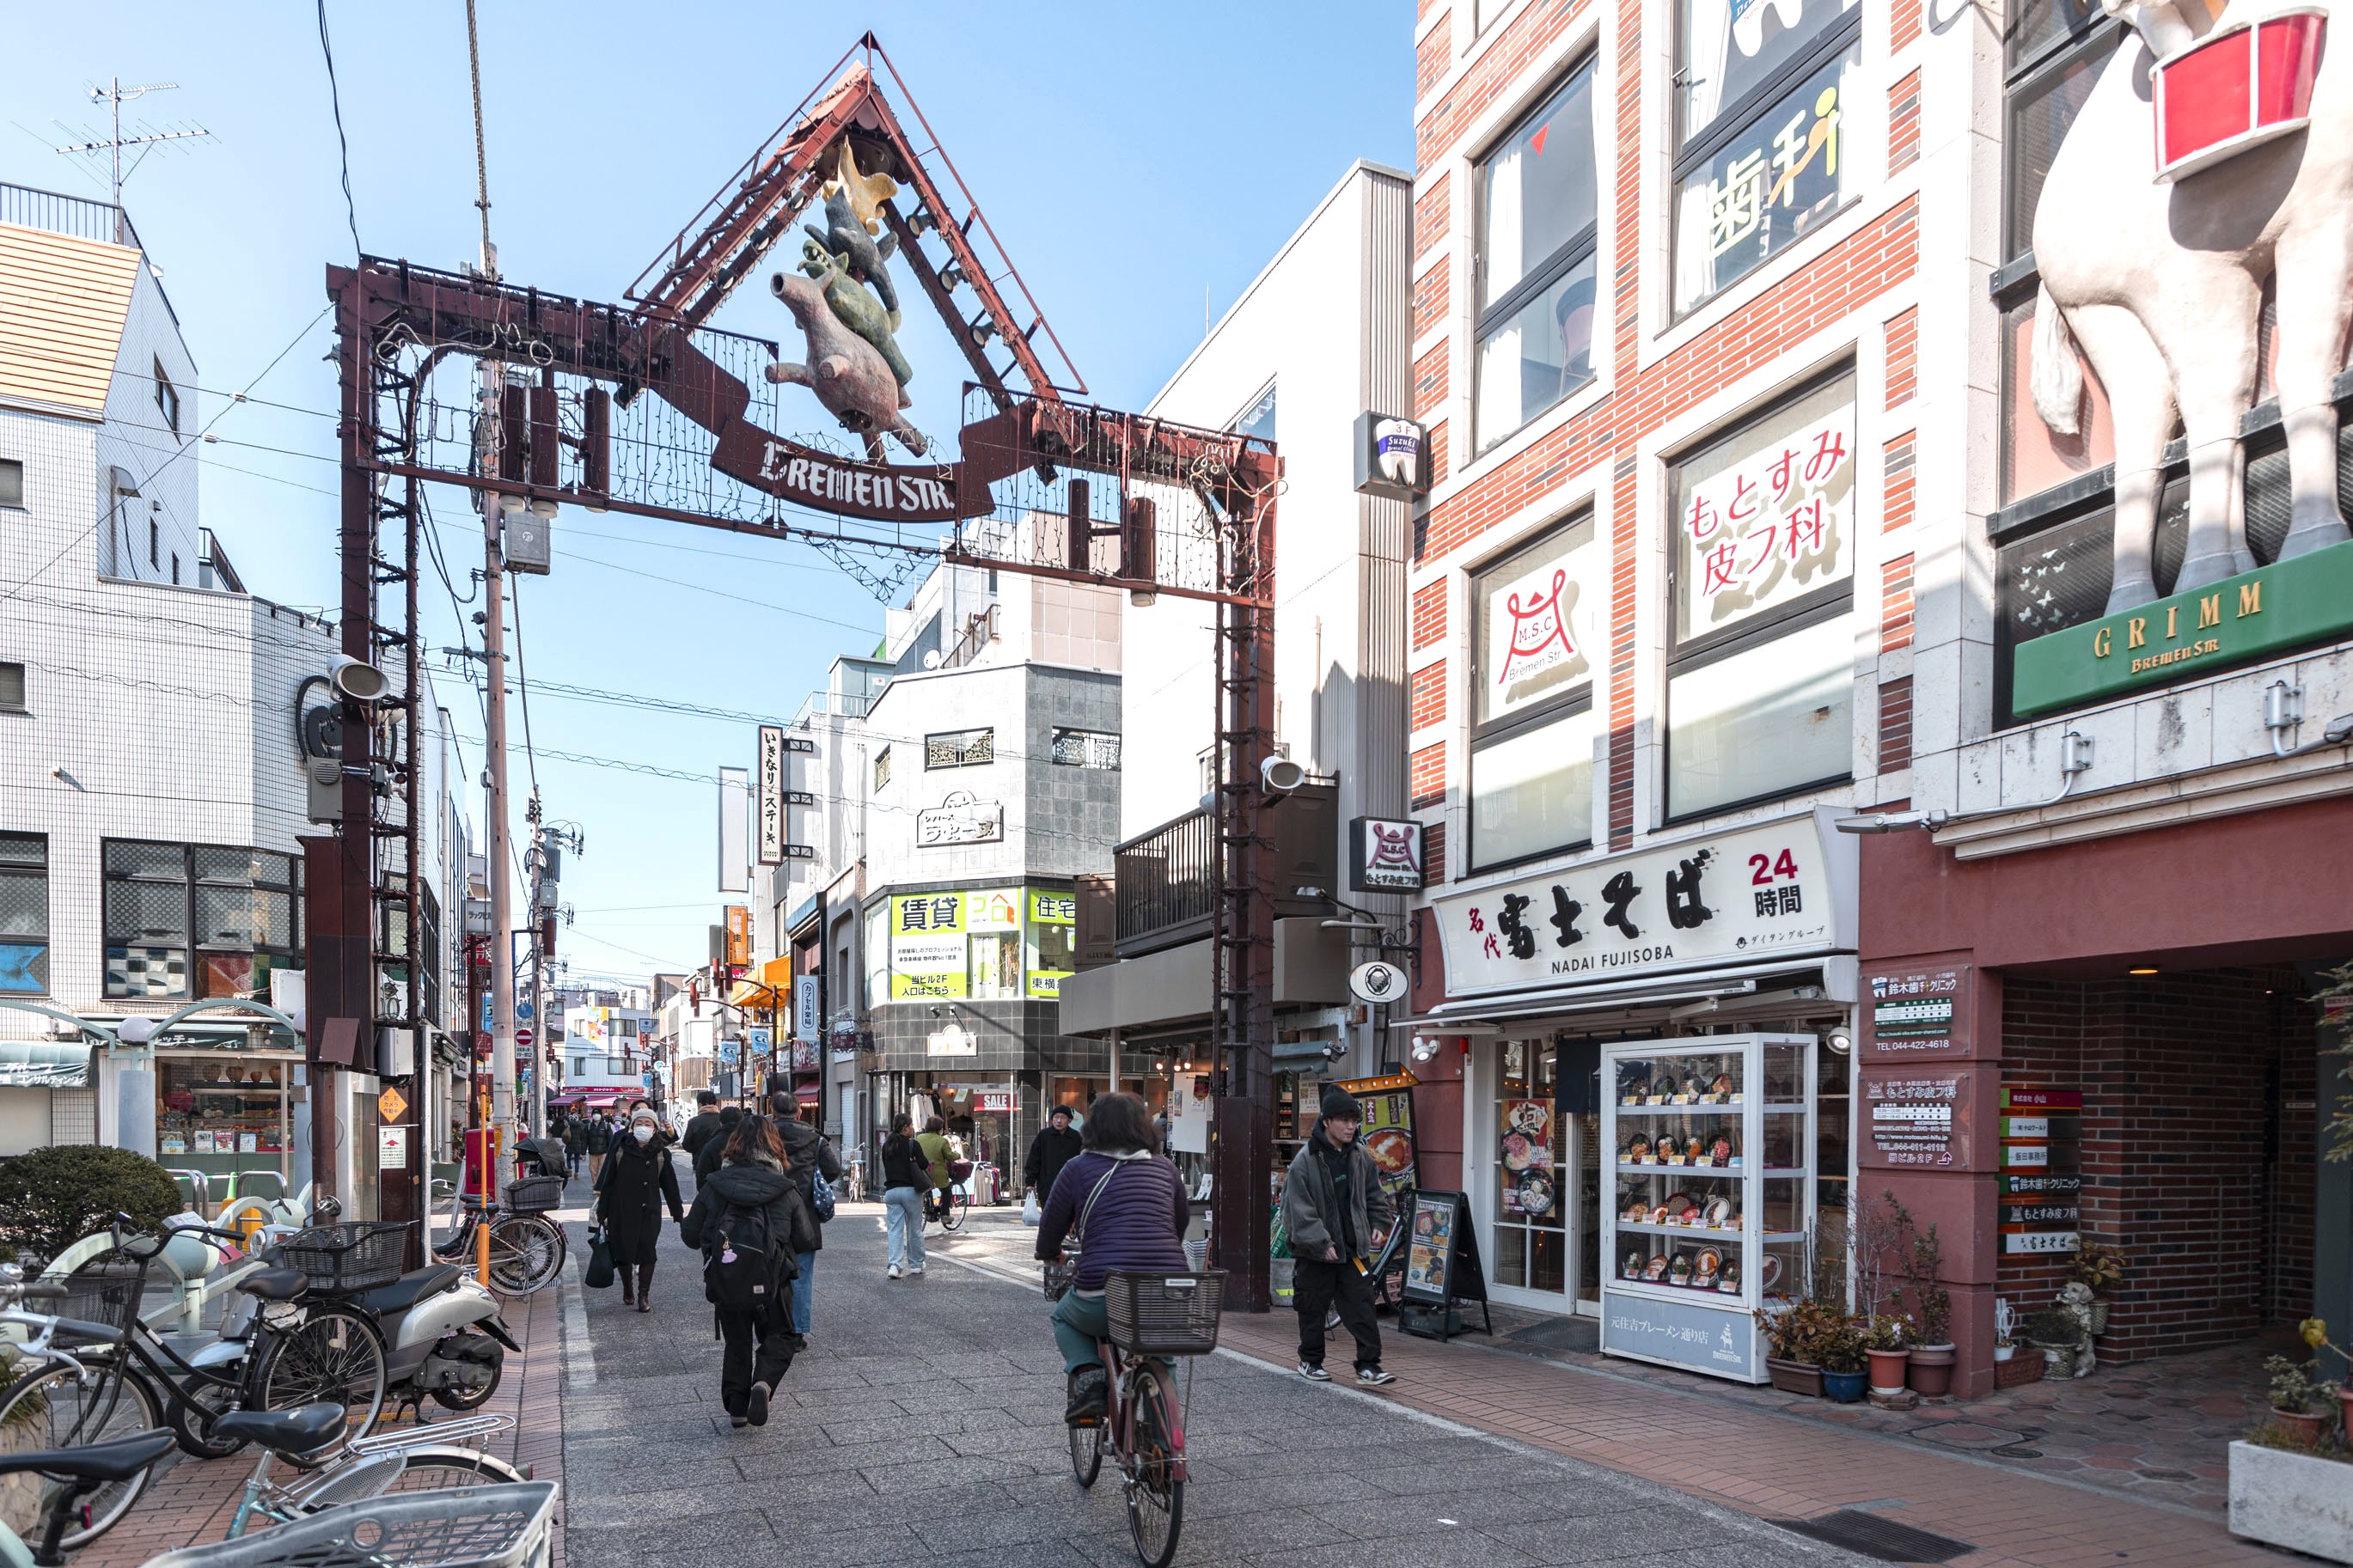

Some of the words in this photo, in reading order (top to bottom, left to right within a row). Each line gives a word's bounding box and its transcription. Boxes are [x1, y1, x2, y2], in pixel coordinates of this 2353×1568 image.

[1709, 87, 1841, 258] 歯科
[1388, 436, 1415, 448] Suzuki
[1688, 430, 1845, 537] もとすみ
[1702, 498, 1824, 596] 皮フ科
[2093, 581, 2262, 658] GRIMM
[1509, 658, 1545, 681] Bremen
[1548, 649, 1562, 667] Str
[1748, 848, 1799, 886] 24
[901, 897, 958, 931] 賃貸
[1036, 896, 1074, 918] 住宅
[1498, 848, 1713, 960] 富士そば
[1754, 884, 1802, 918] 時間
[1469, 907, 1500, 959] 名代
[1751, 924, 1824, 946] ダイタングループ
[1552, 956, 1595, 974] NADAI
[1602, 944, 1673, 967] FUJISOBA
[901, 985, 949, 997] 入口はこちら
[911, 974, 948, 985] 当ビル2F
[1032, 978, 1064, 990] 東横
[1888, 979, 1957, 996] 鈴木歯科クリニック
[1892, 1040, 1950, 1050] 044-422-4618
[983, 1094, 1007, 1107] SALE
[1886, 1086, 1957, 1099] もとすみ皮フ科
[2020, 1178, 2080, 1190] 鈴木歯科クリニック
[2024, 1207, 2078, 1220] もとすみ皮フ科
[1610, 1315, 1709, 1345] 元住吉ブレーメン通り店
